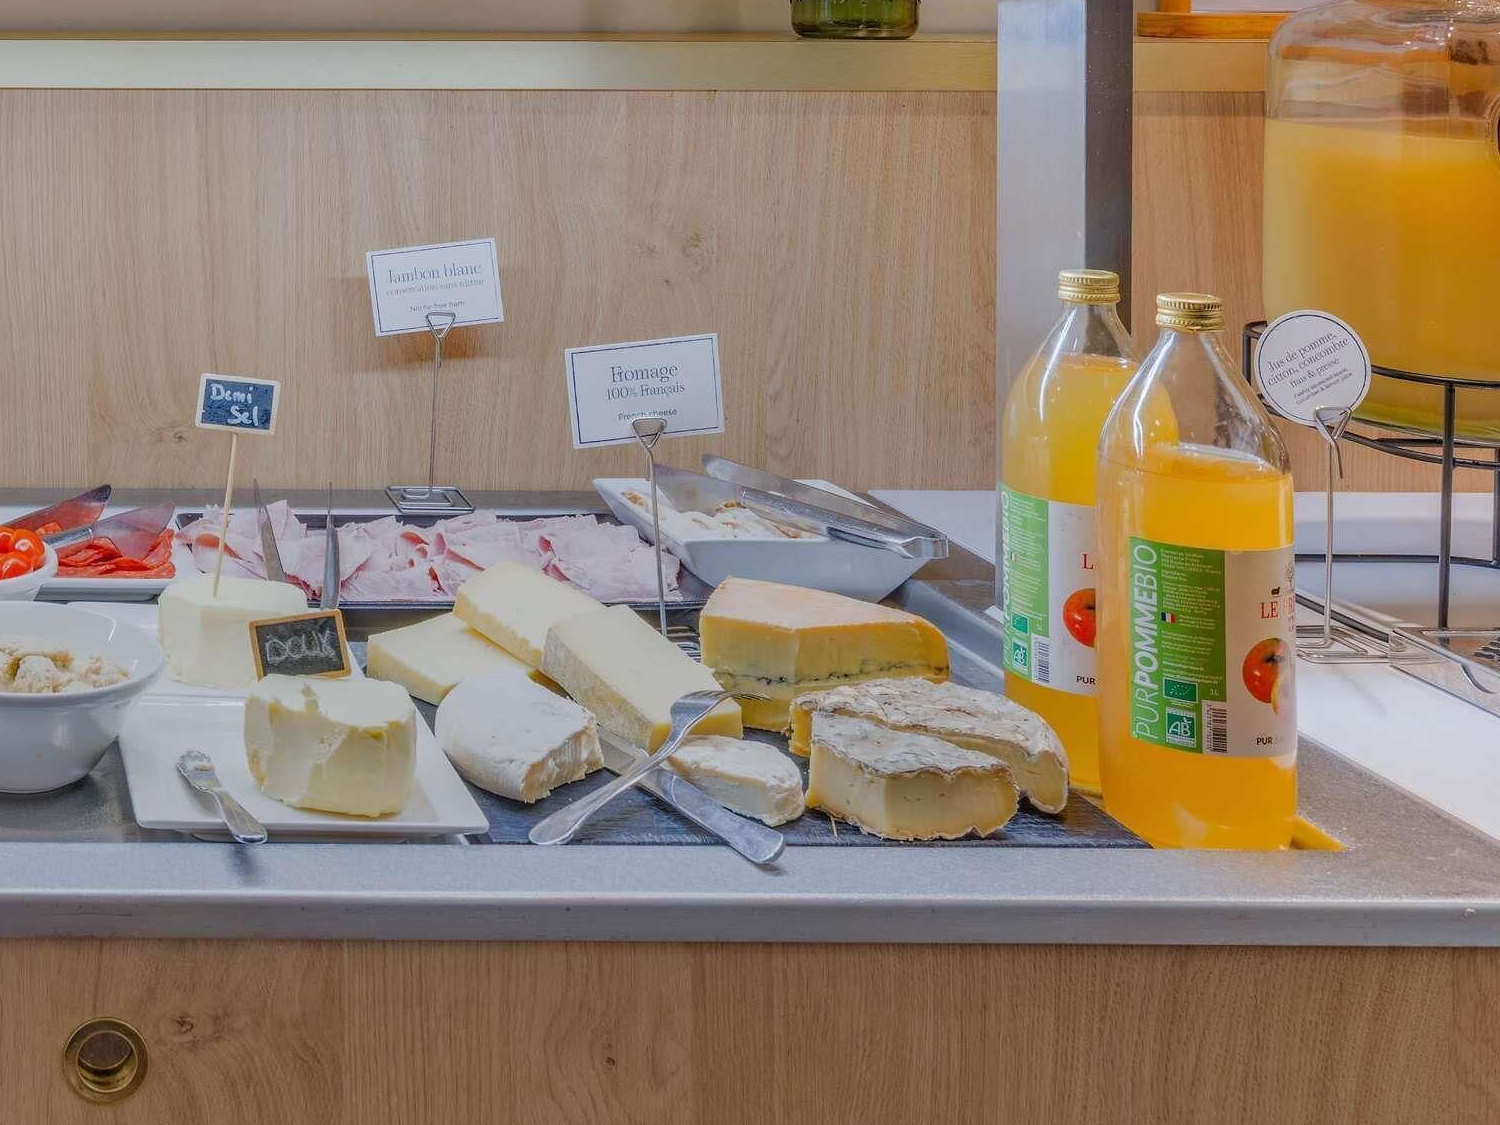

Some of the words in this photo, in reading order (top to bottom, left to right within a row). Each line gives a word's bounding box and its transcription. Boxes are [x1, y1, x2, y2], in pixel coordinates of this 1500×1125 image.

[388, 266, 441, 284] Jambon
[442, 262, 482, 278] blanc
[1284, 350, 1298, 363] de
[610, 364, 679, 383] Fromage
[210, 383, 254, 404] Demi
[606, 386, 638, 401] 100%
[639, 381, 685, 397] Français
[227, 405, 259, 426] Sel
[1260, 601, 1279, 619] LE
[1075, 675, 1096, 686] PUR
[1256, 736, 1273, 746] PUR
